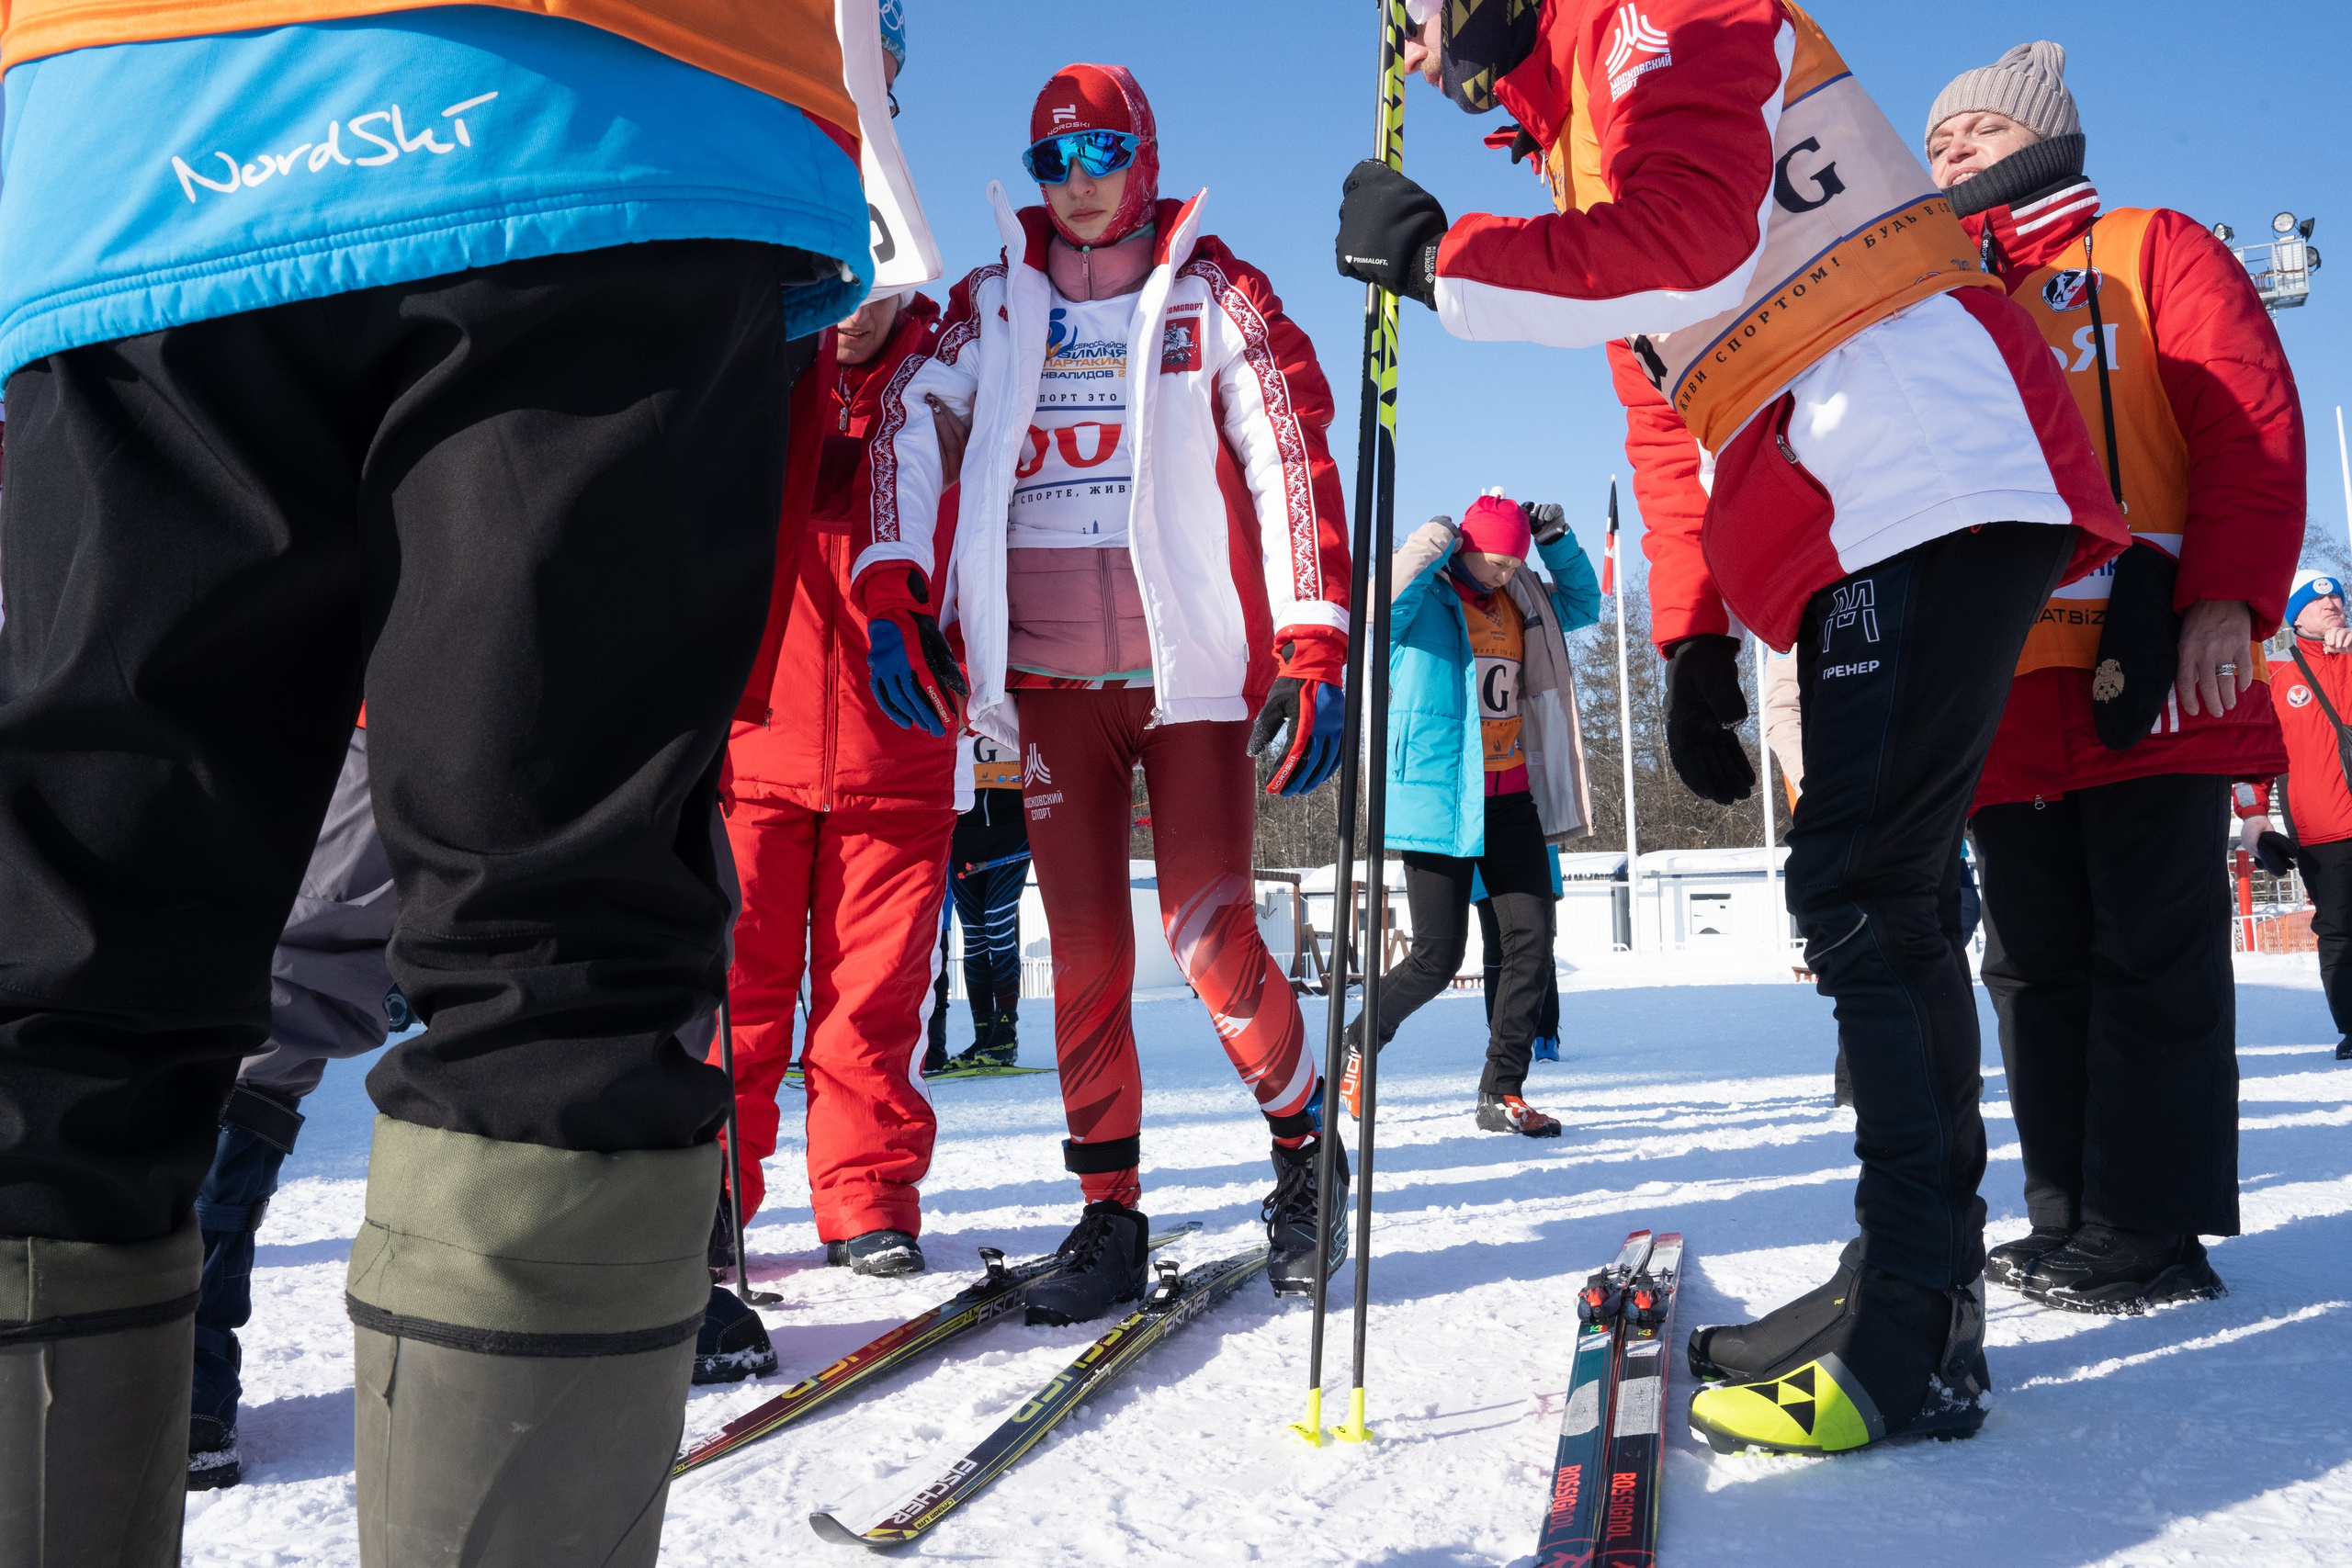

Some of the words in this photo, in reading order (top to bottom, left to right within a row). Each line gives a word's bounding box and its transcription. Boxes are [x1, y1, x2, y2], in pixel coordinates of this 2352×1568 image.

[1610, 53, 1672, 92] МОСКОВСКИЙ
[1611, 77, 1638, 103] СПОРТ
[1047, 121, 1091, 137] NORDSKI
[1773, 136, 1846, 213] G
[1715, 256, 1840, 364] СПОРТОМ!
[1863, 215, 1917, 249] БУДЬ
[1166, 302, 1204, 314] ОМСПОРТ
[1057, 346, 1127, 359] ЗИМНЯ
[1069, 341, 1127, 352] СЕРОССИЙСК
[1040, 369, 1114, 380] НВАЛИДОВ
[1043, 356, 1127, 367] ПАРТАКИАД
[1039, 394, 1078, 402] ПОРТ
[1088, 393, 1117, 401] ЭТО
[1021, 488, 1080, 504] СПОРТЕ,
[1090, 484, 1133, 495] ЖИВ
[1823, 660, 1880, 680] ТРЕНЕР
[1483, 664, 1509, 712] G
[927, 685, 951, 724] NORDSKI
[974, 736, 998, 763] G
[1272, 755, 1296, 791] NORDSKI
[1031, 807, 1052, 821] СПОРТ
[978, 1285, 1026, 1324] FISCH
[1164, 1290, 1210, 1337] FISCHER
[890, 1458, 978, 1525] FISCHER
[1549, 1464, 1582, 1534] ROSSIGNOL
[1607, 1472, 1637, 1542] ROSSIGNOL
